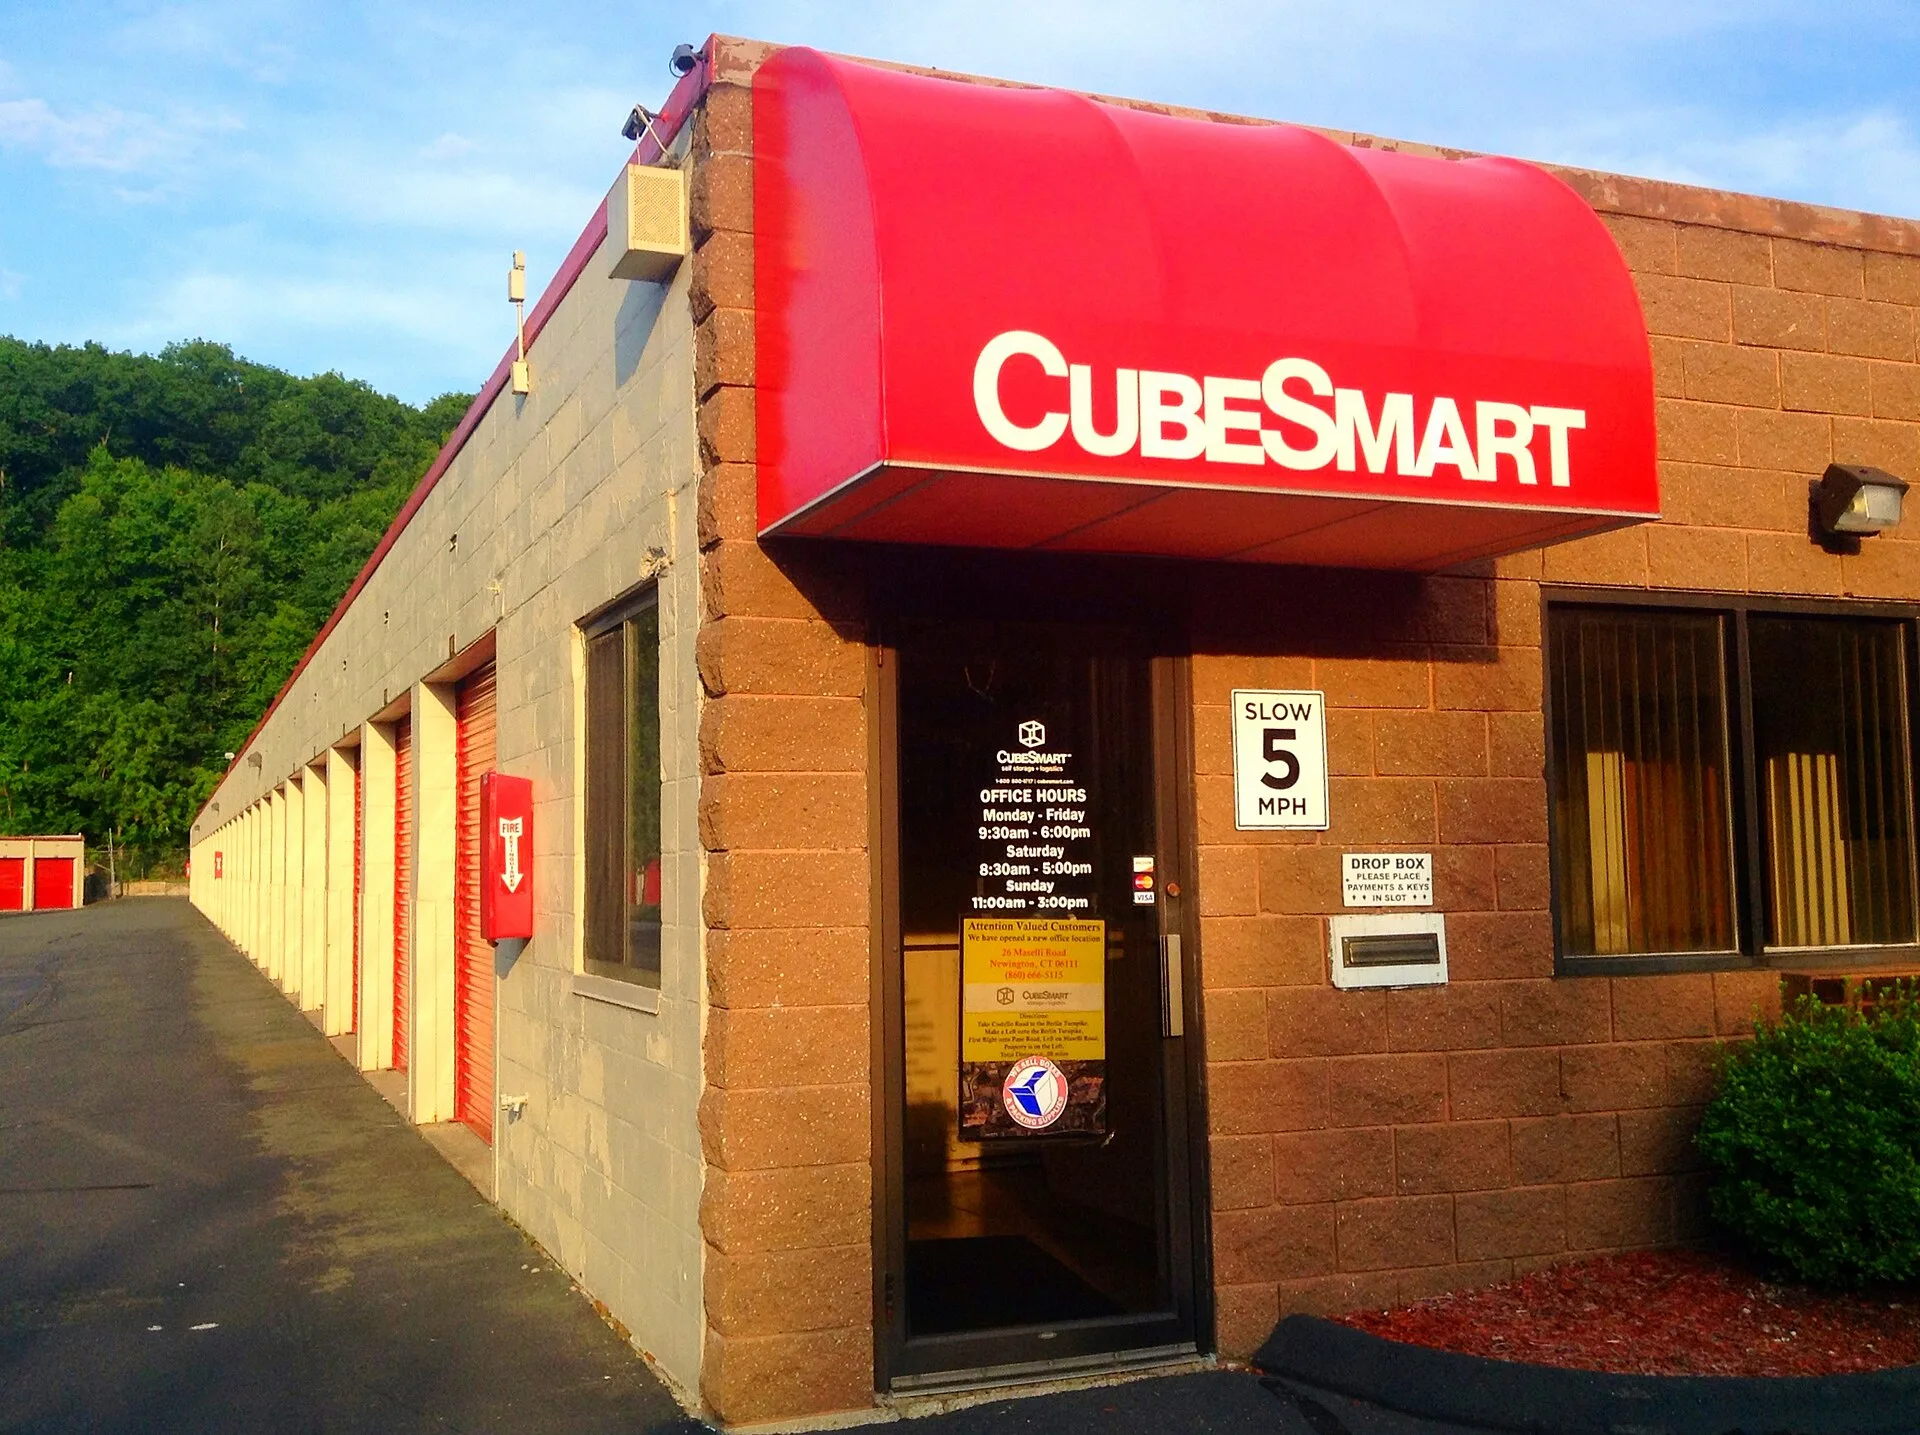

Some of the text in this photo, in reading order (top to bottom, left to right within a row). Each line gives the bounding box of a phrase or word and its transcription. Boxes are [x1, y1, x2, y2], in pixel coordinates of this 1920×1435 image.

[973, 330, 1586, 487] CUBESMART
[1245, 702, 1312, 721] SLOW
[996, 750, 1068, 764] CUBESMART
[1260, 728, 1300, 790] 5
[980, 789, 1087, 803] OFFICE HOURS
[1258, 797, 1307, 816] MPH
[983, 809, 1035, 823] Monday
[1046, 808, 1085, 823] Friday
[502, 823, 520, 833] FIRE
[978, 826, 1029, 840] 9:30am
[1041, 826, 1091, 840] 6:00pm
[1006, 844, 1065, 859] Saturday
[979, 863, 1031, 876] 8:30am
[1042, 862, 1092, 876] 5:00pm
[1351, 858, 1425, 869] DROP BOX
[1393, 872, 1420, 880] PLACE
[1006, 880, 1055, 893] Sunday
[1407, 883, 1430, 891] KEYS
[971, 897, 1026, 909] 11:00am
[1037, 896, 1088, 910] 3:00pm
[1136, 894, 1153, 902] VISA
[1384, 894, 1407, 902] SLOT
[968, 921, 1101, 931] Attention Valued Customers
[1000, 934, 1025, 943] opened
[1050, 934, 1070, 942] office
[1071, 934, 1101, 942] location
[1002, 948, 1067, 957] 26 Maselli Road
[990, 960, 1078, 969] Newington, CT 06111
[1022, 990, 1069, 1000] CUBESMART
[1011, 1065, 1022, 1077] WE
[1020, 1058, 1038, 1068] SELL
[1009, 1104, 1037, 1126] PACKING
[1037, 1096, 1065, 1125] SUPPLIES
